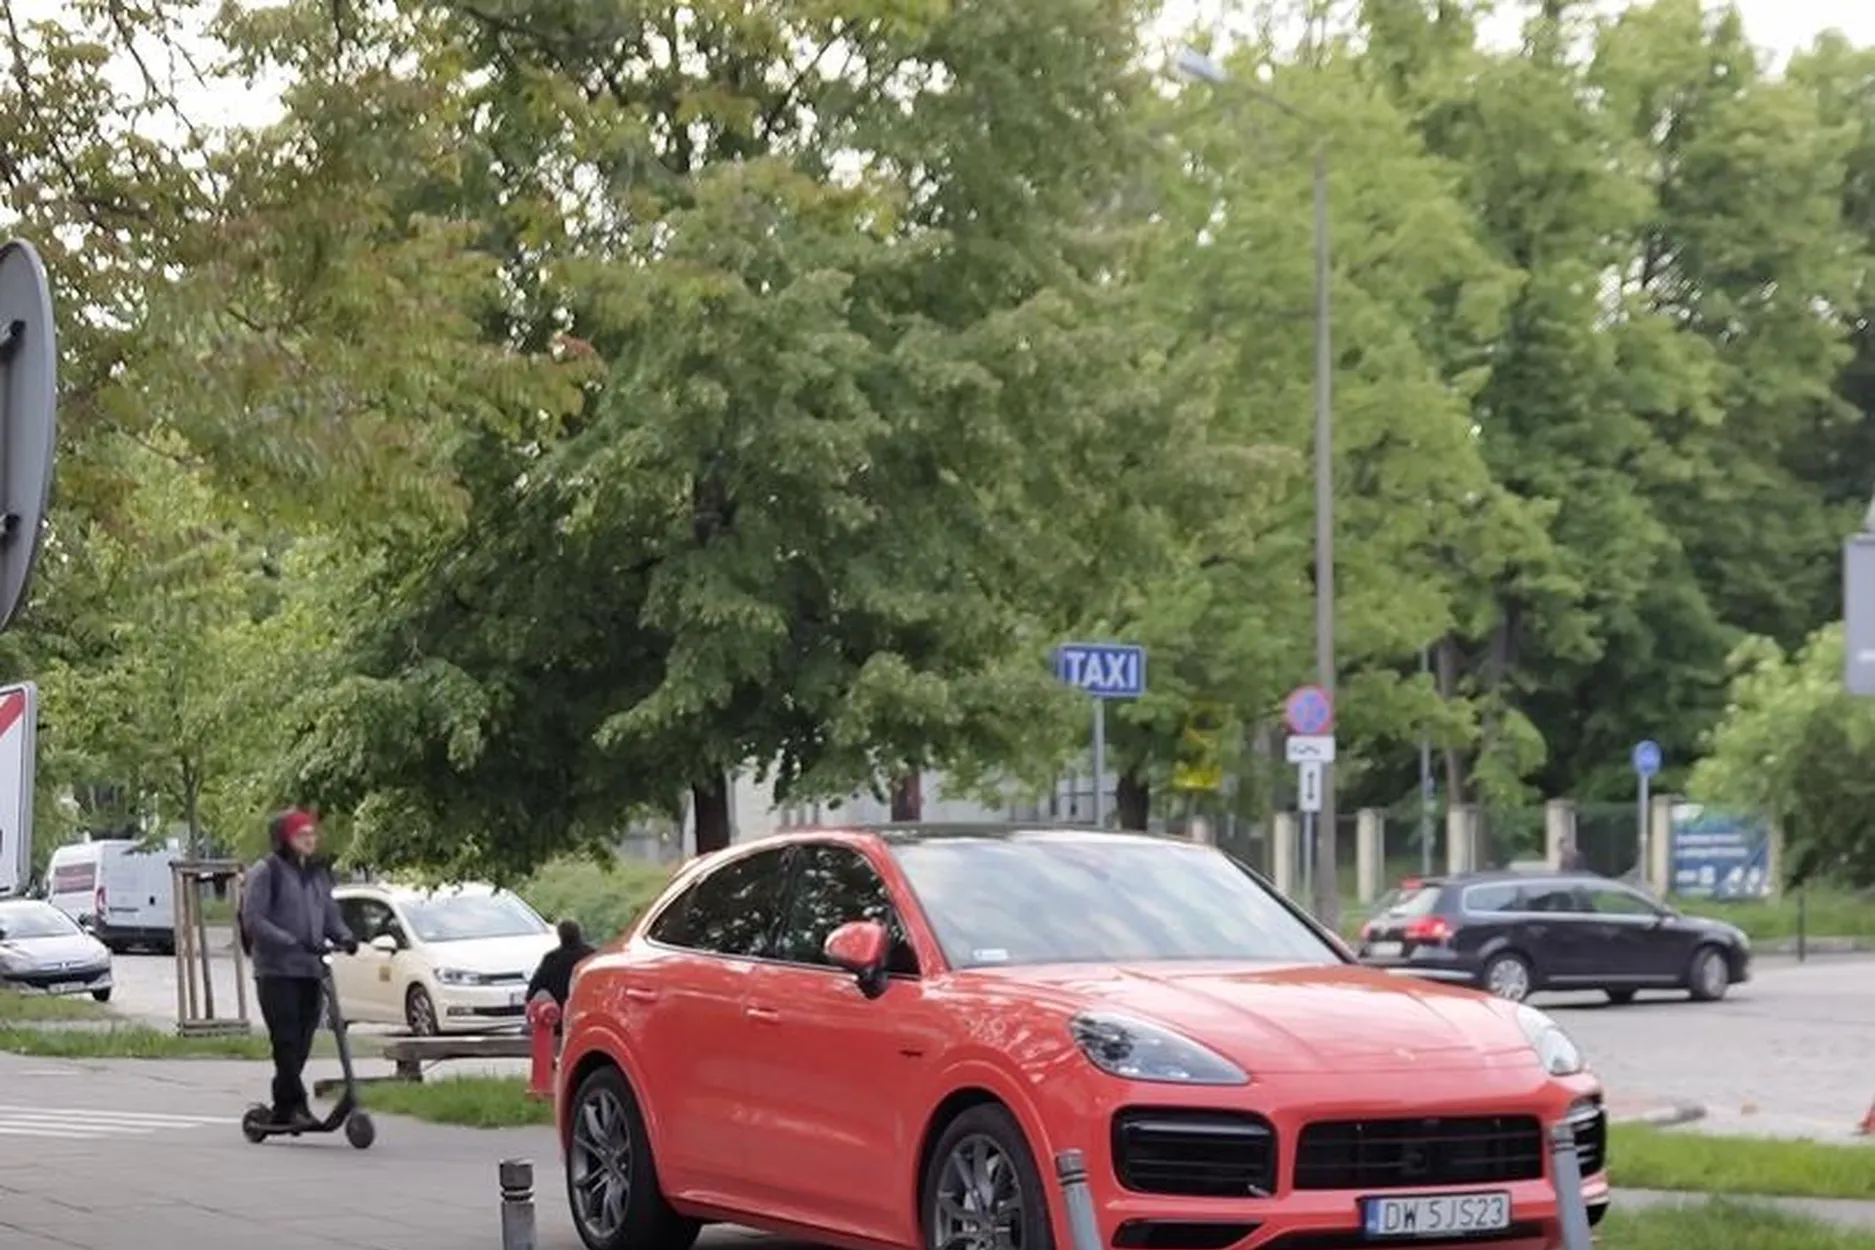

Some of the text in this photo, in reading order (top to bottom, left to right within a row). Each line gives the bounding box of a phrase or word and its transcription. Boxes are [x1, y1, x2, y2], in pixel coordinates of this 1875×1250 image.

[1066, 651, 1137, 688] TAXI
[1384, 1197, 1504, 1231] DW 5JS23
